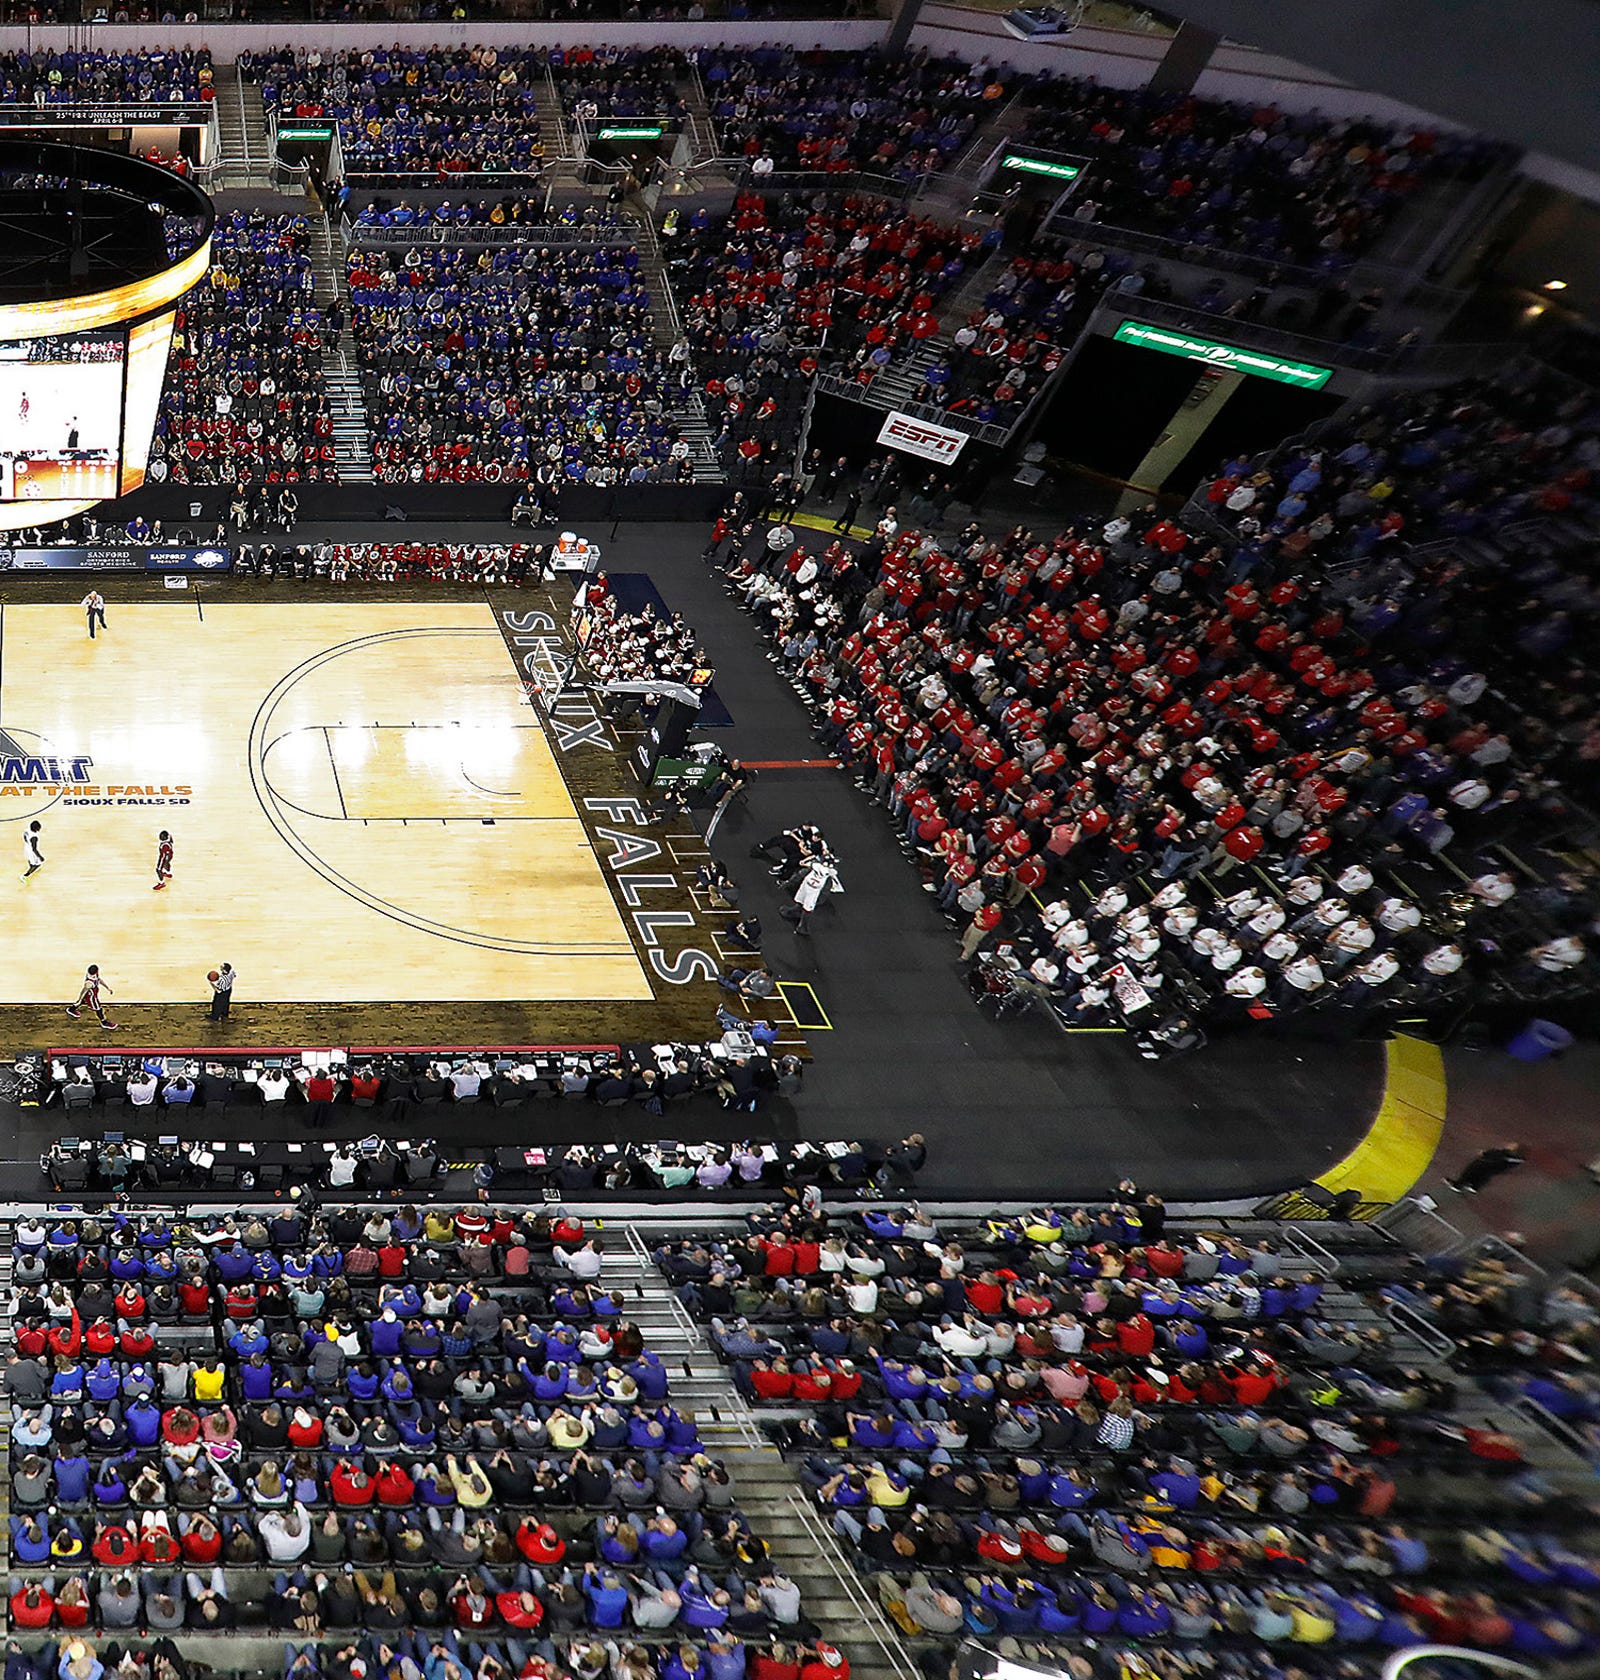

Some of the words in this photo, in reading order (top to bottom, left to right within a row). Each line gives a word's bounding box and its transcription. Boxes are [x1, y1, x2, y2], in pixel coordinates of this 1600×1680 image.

[138, 111, 161, 119] BEAST
[888, 419, 960, 452] ESPN
[0, 786, 37, 797] AT
[43, 785, 104, 796] THE
[107, 785, 193, 796] FALLS
[63, 798, 114, 806] SIOUX
[117, 798, 165, 806] FALLS
[583, 797, 720, 985] FALLS
